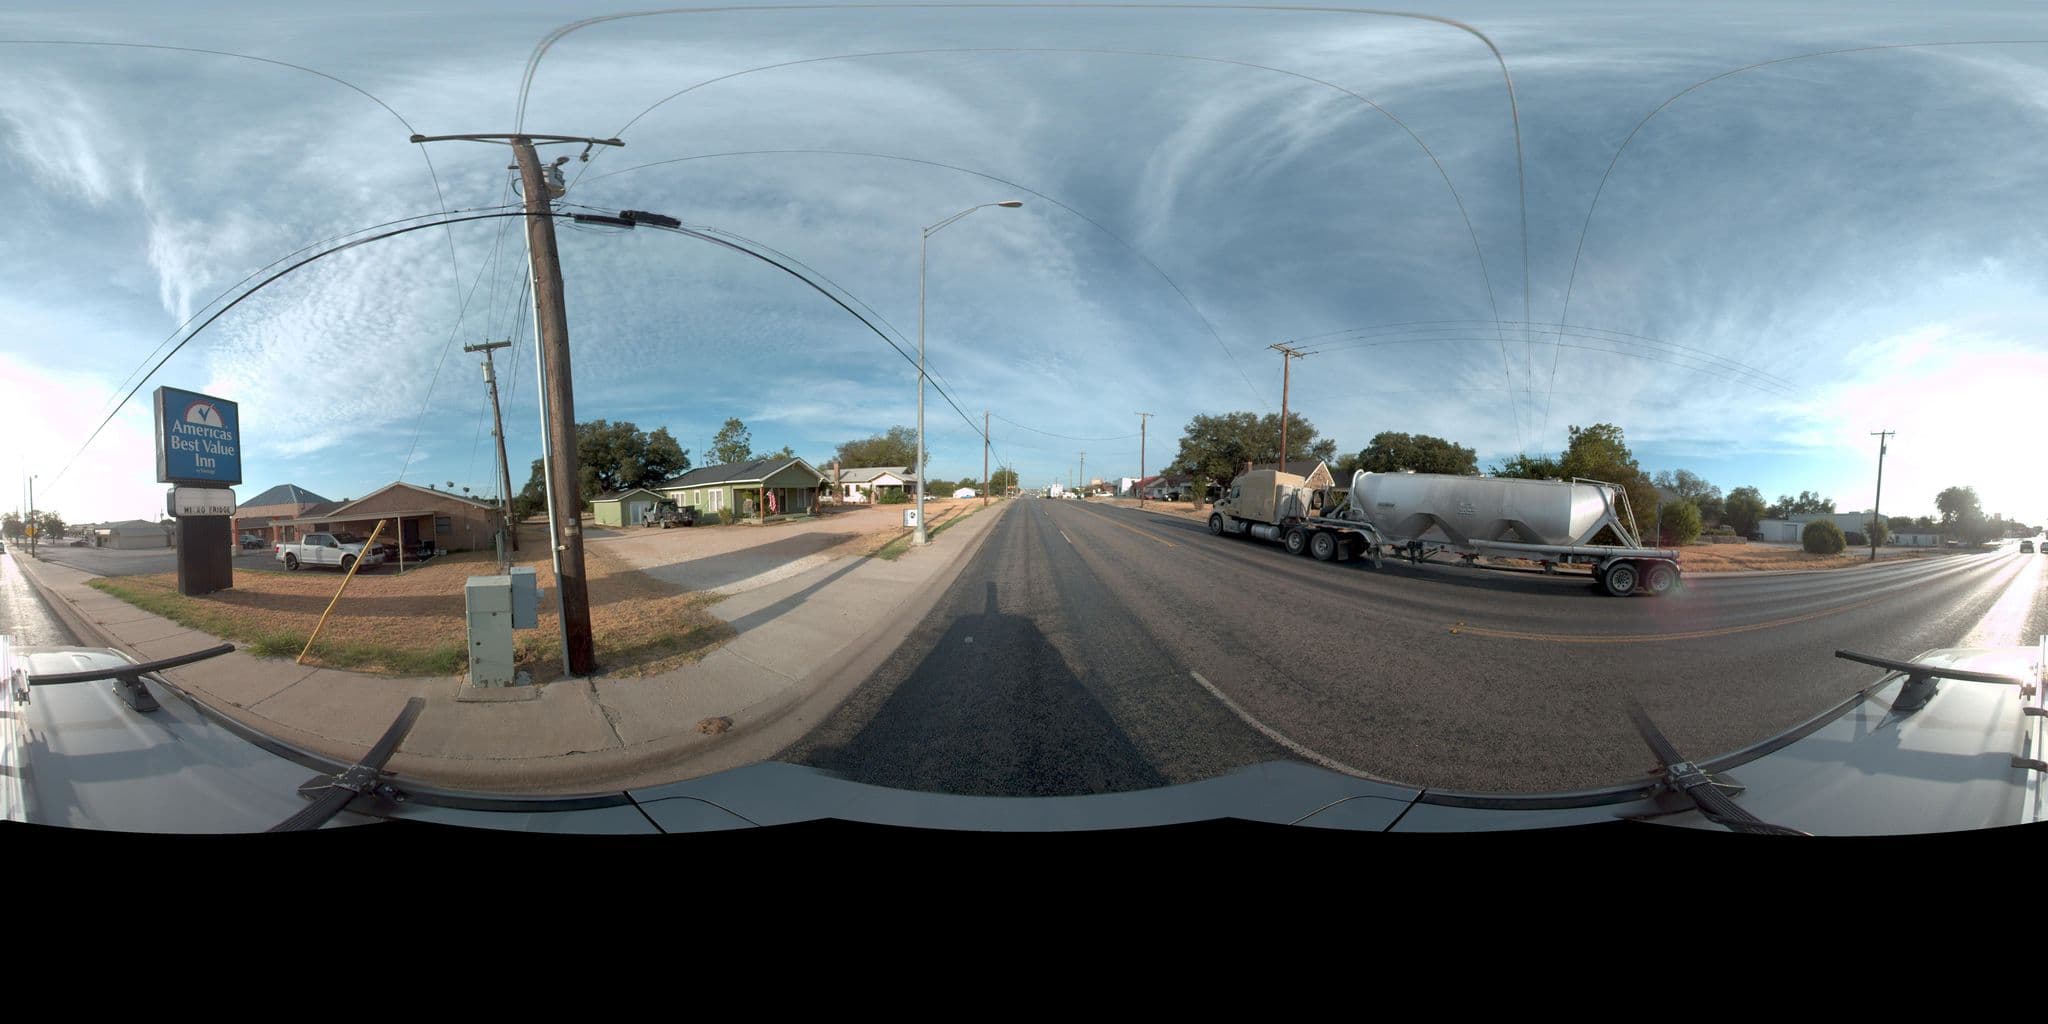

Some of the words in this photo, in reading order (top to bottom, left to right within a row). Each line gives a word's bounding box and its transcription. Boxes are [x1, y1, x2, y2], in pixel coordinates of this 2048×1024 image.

[172, 419, 233, 441] Americas
[171, 435, 200, 452] Best
[203, 439, 235, 456] Value
[195, 453, 216, 468] Inn
